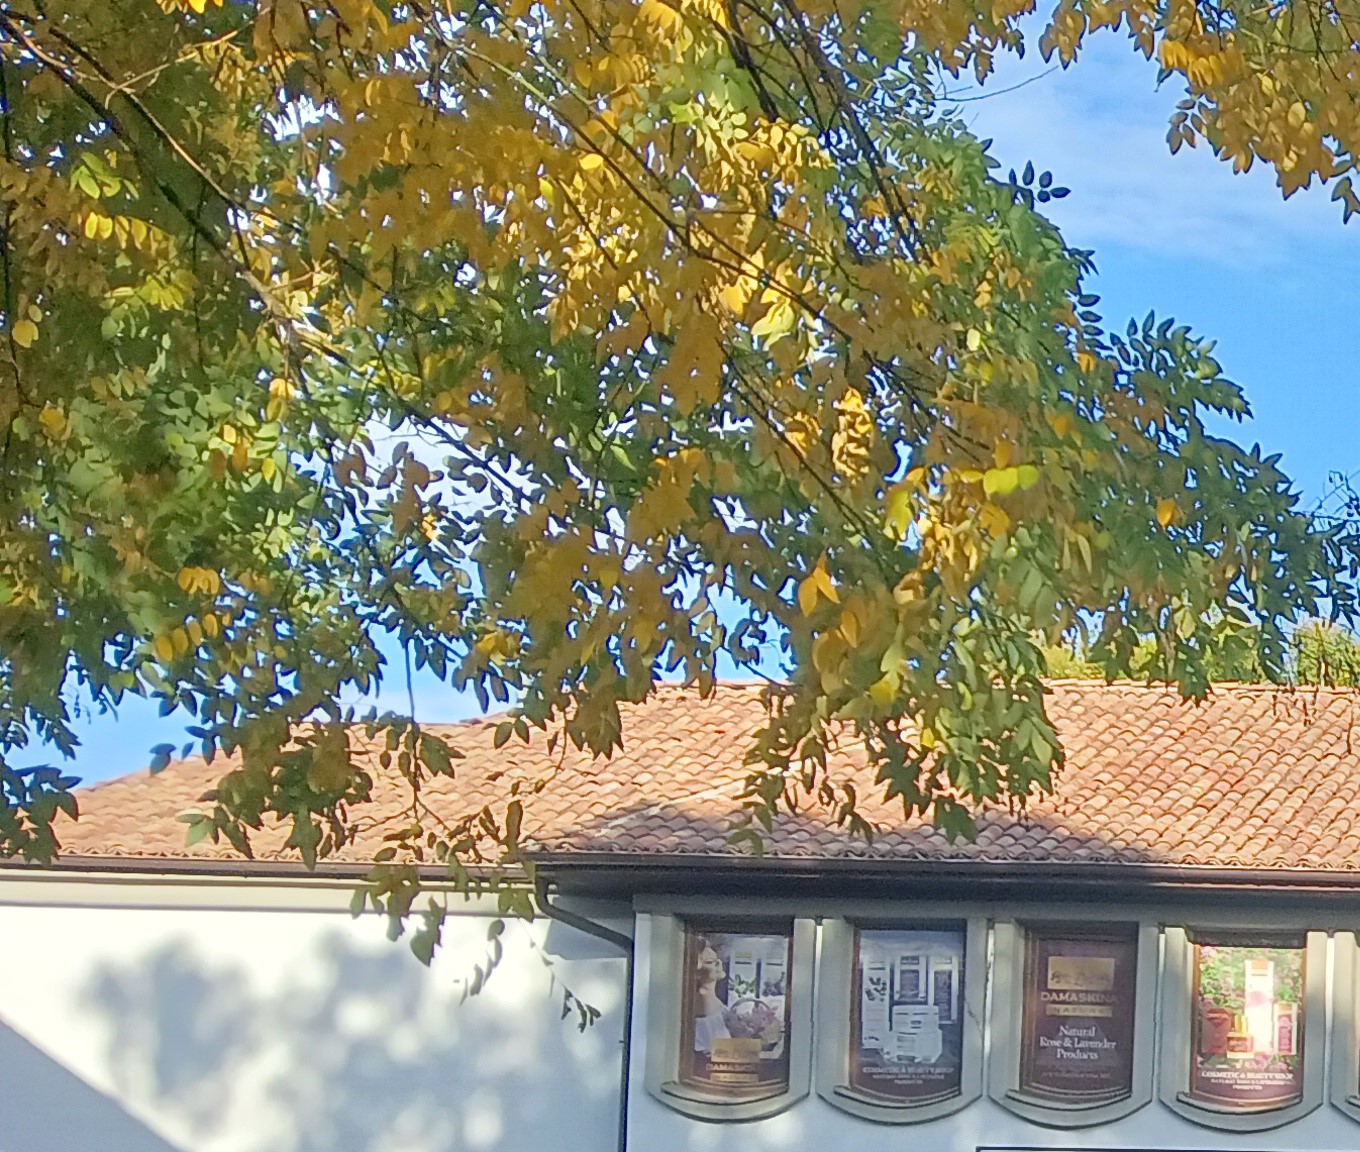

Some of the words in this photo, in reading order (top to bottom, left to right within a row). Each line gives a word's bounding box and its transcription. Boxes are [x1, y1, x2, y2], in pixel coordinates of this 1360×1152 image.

[1060, 1026, 1096, 1037] Natural
[1040, 1036, 1062, 1047] Rose
[1063, 1037, 1072, 1047] &
[1074, 1037, 1116, 1049] Lavender
[1057, 1048, 1098, 1059] Products
